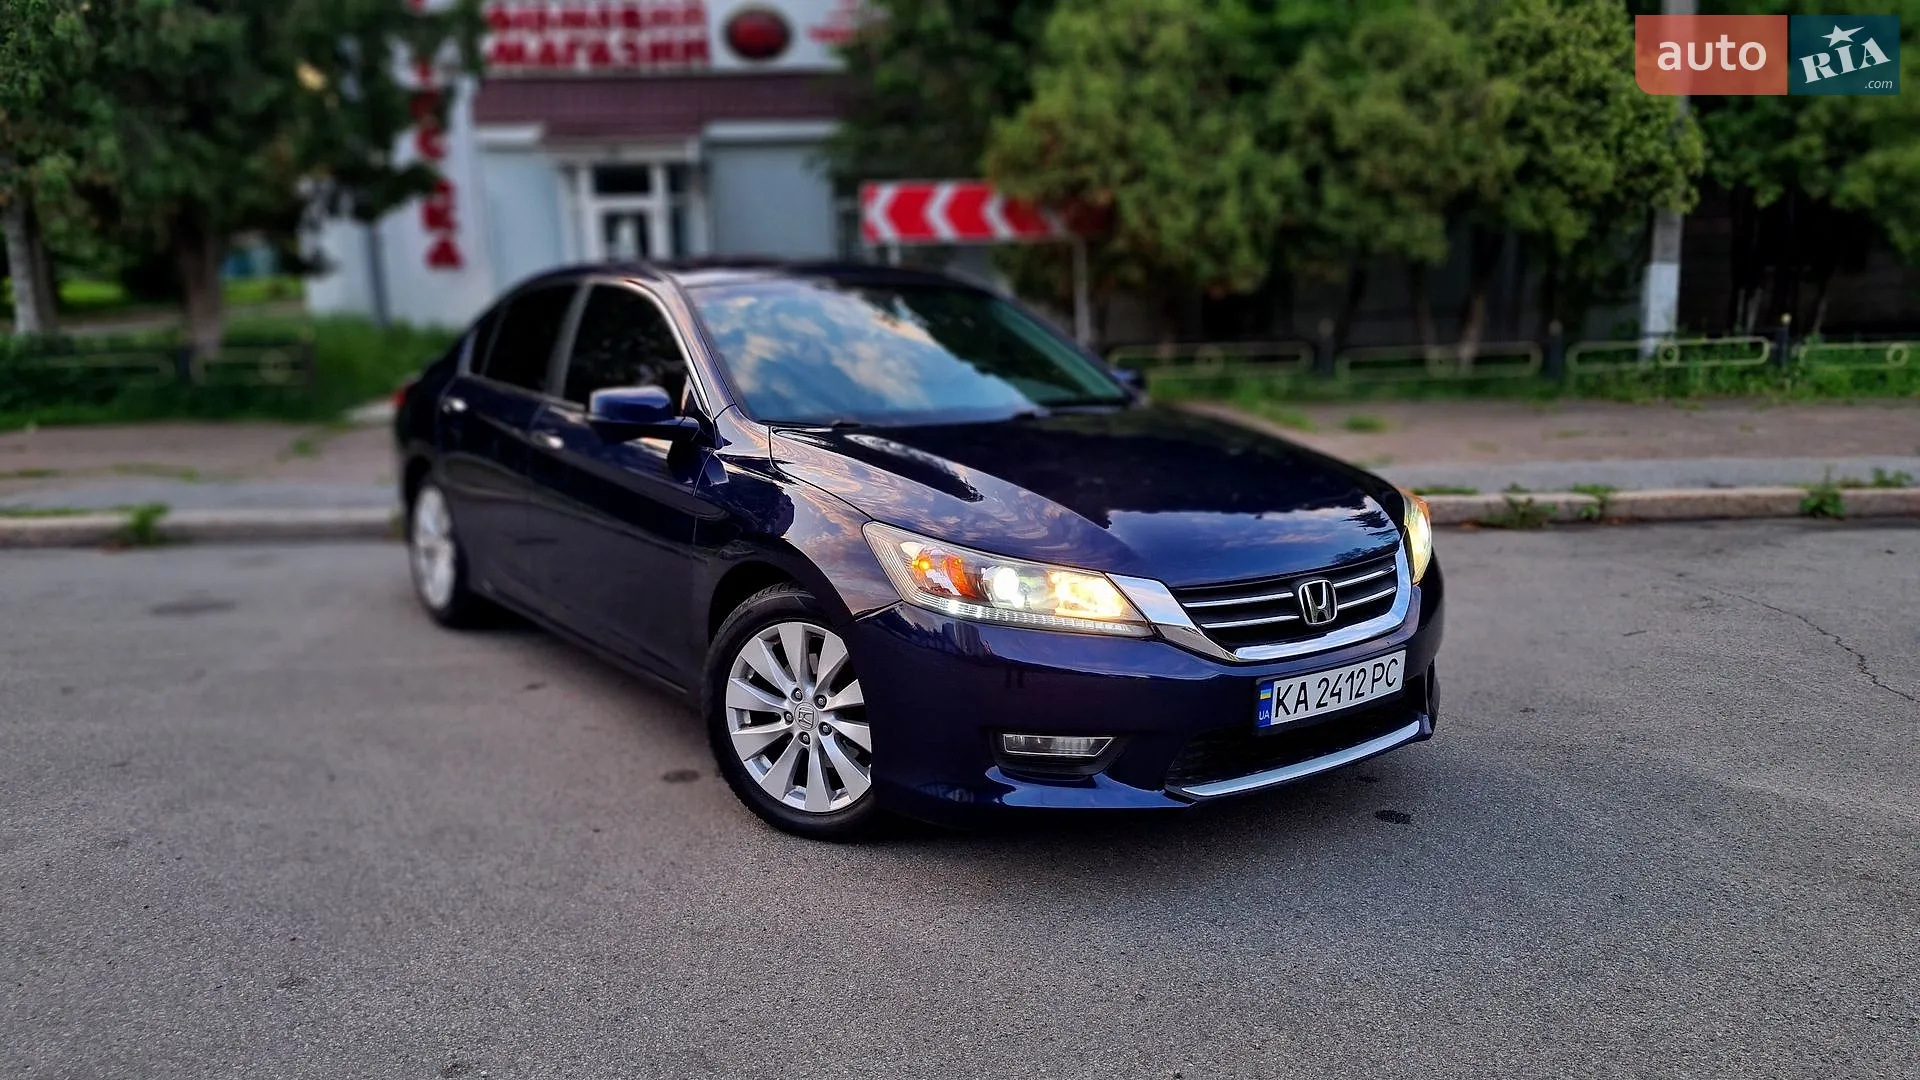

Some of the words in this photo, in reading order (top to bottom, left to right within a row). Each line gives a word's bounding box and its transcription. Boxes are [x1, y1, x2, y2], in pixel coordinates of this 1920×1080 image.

[487, 39, 710, 66] МАГАЗИН
[1274, 681, 1309, 718] KA
[1315, 667, 1367, 709] 2412
[1370, 658, 1399, 694] PC
[1259, 710, 1270, 721] UA
